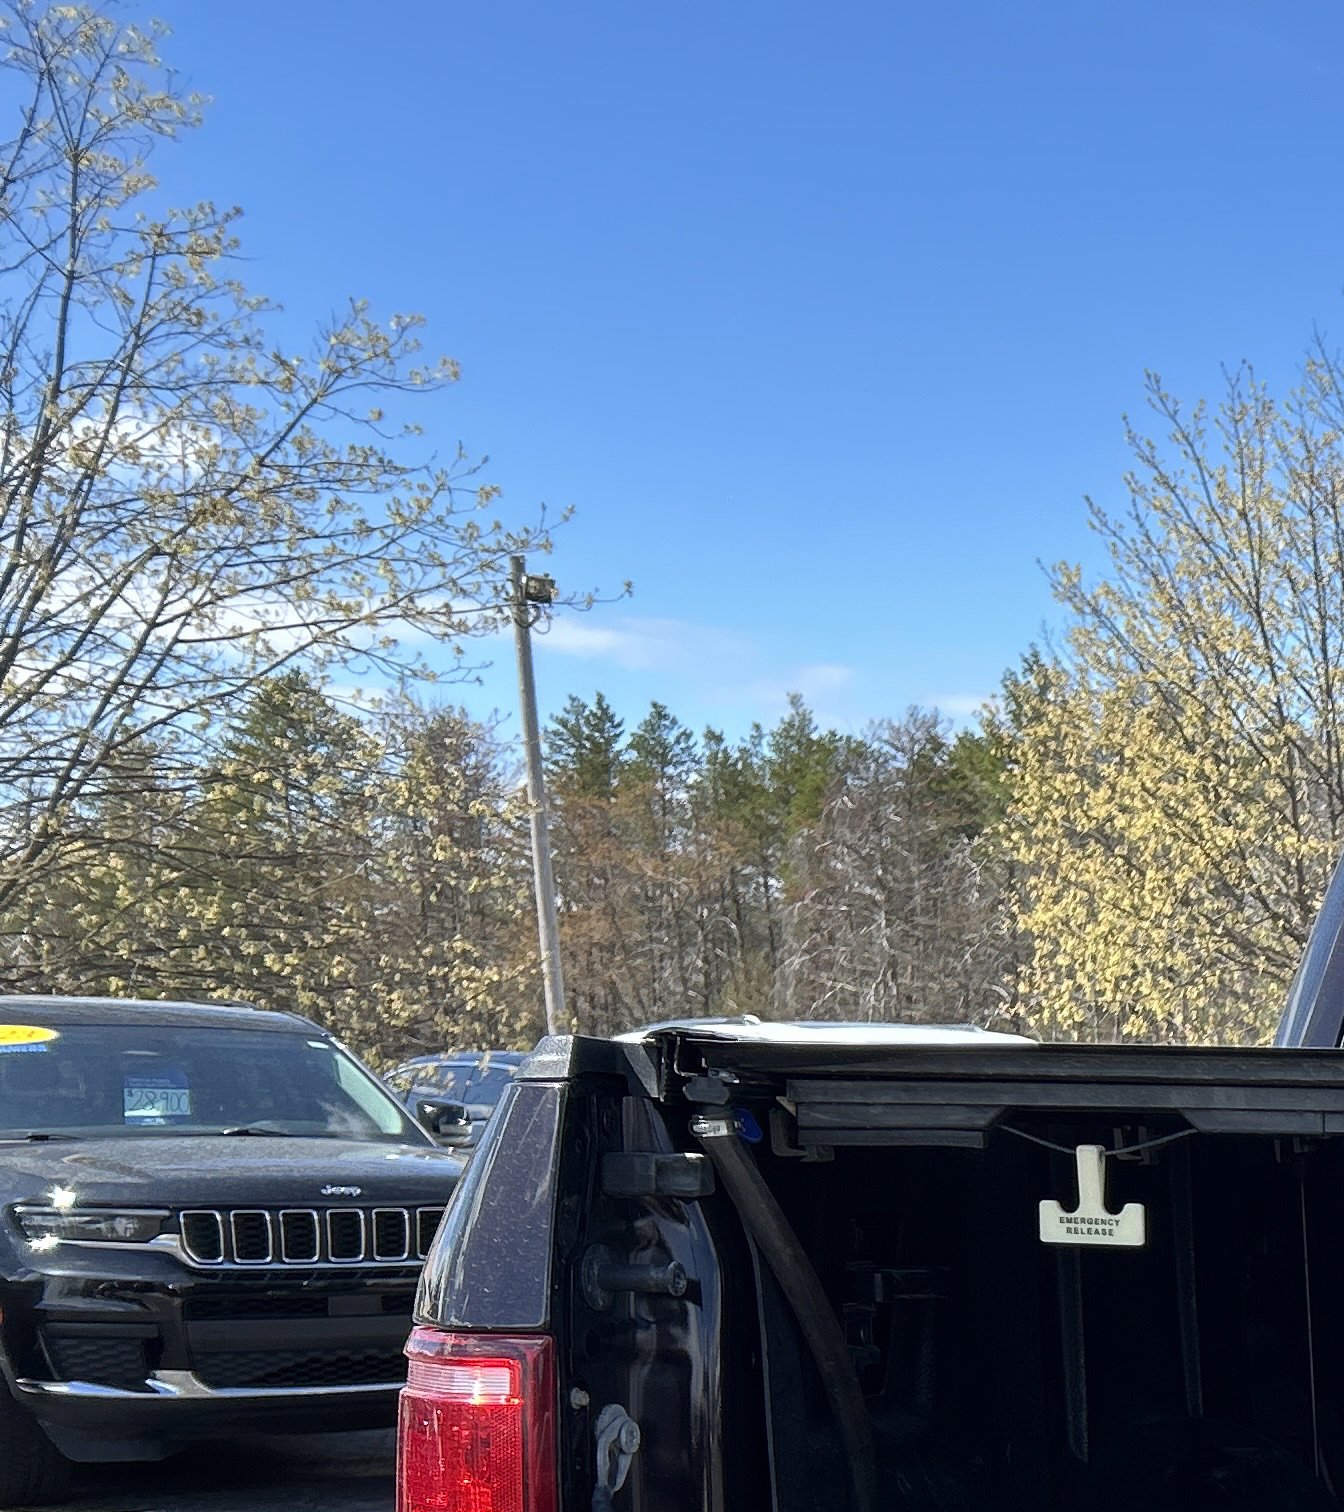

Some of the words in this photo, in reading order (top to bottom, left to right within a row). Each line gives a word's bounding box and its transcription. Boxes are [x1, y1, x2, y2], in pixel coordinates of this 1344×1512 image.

[321, 1184, 361, 1196] Jeep
[1059, 1216, 1120, 1227] EMERGENCY
[1066, 1226, 1114, 1237] RELEASE
